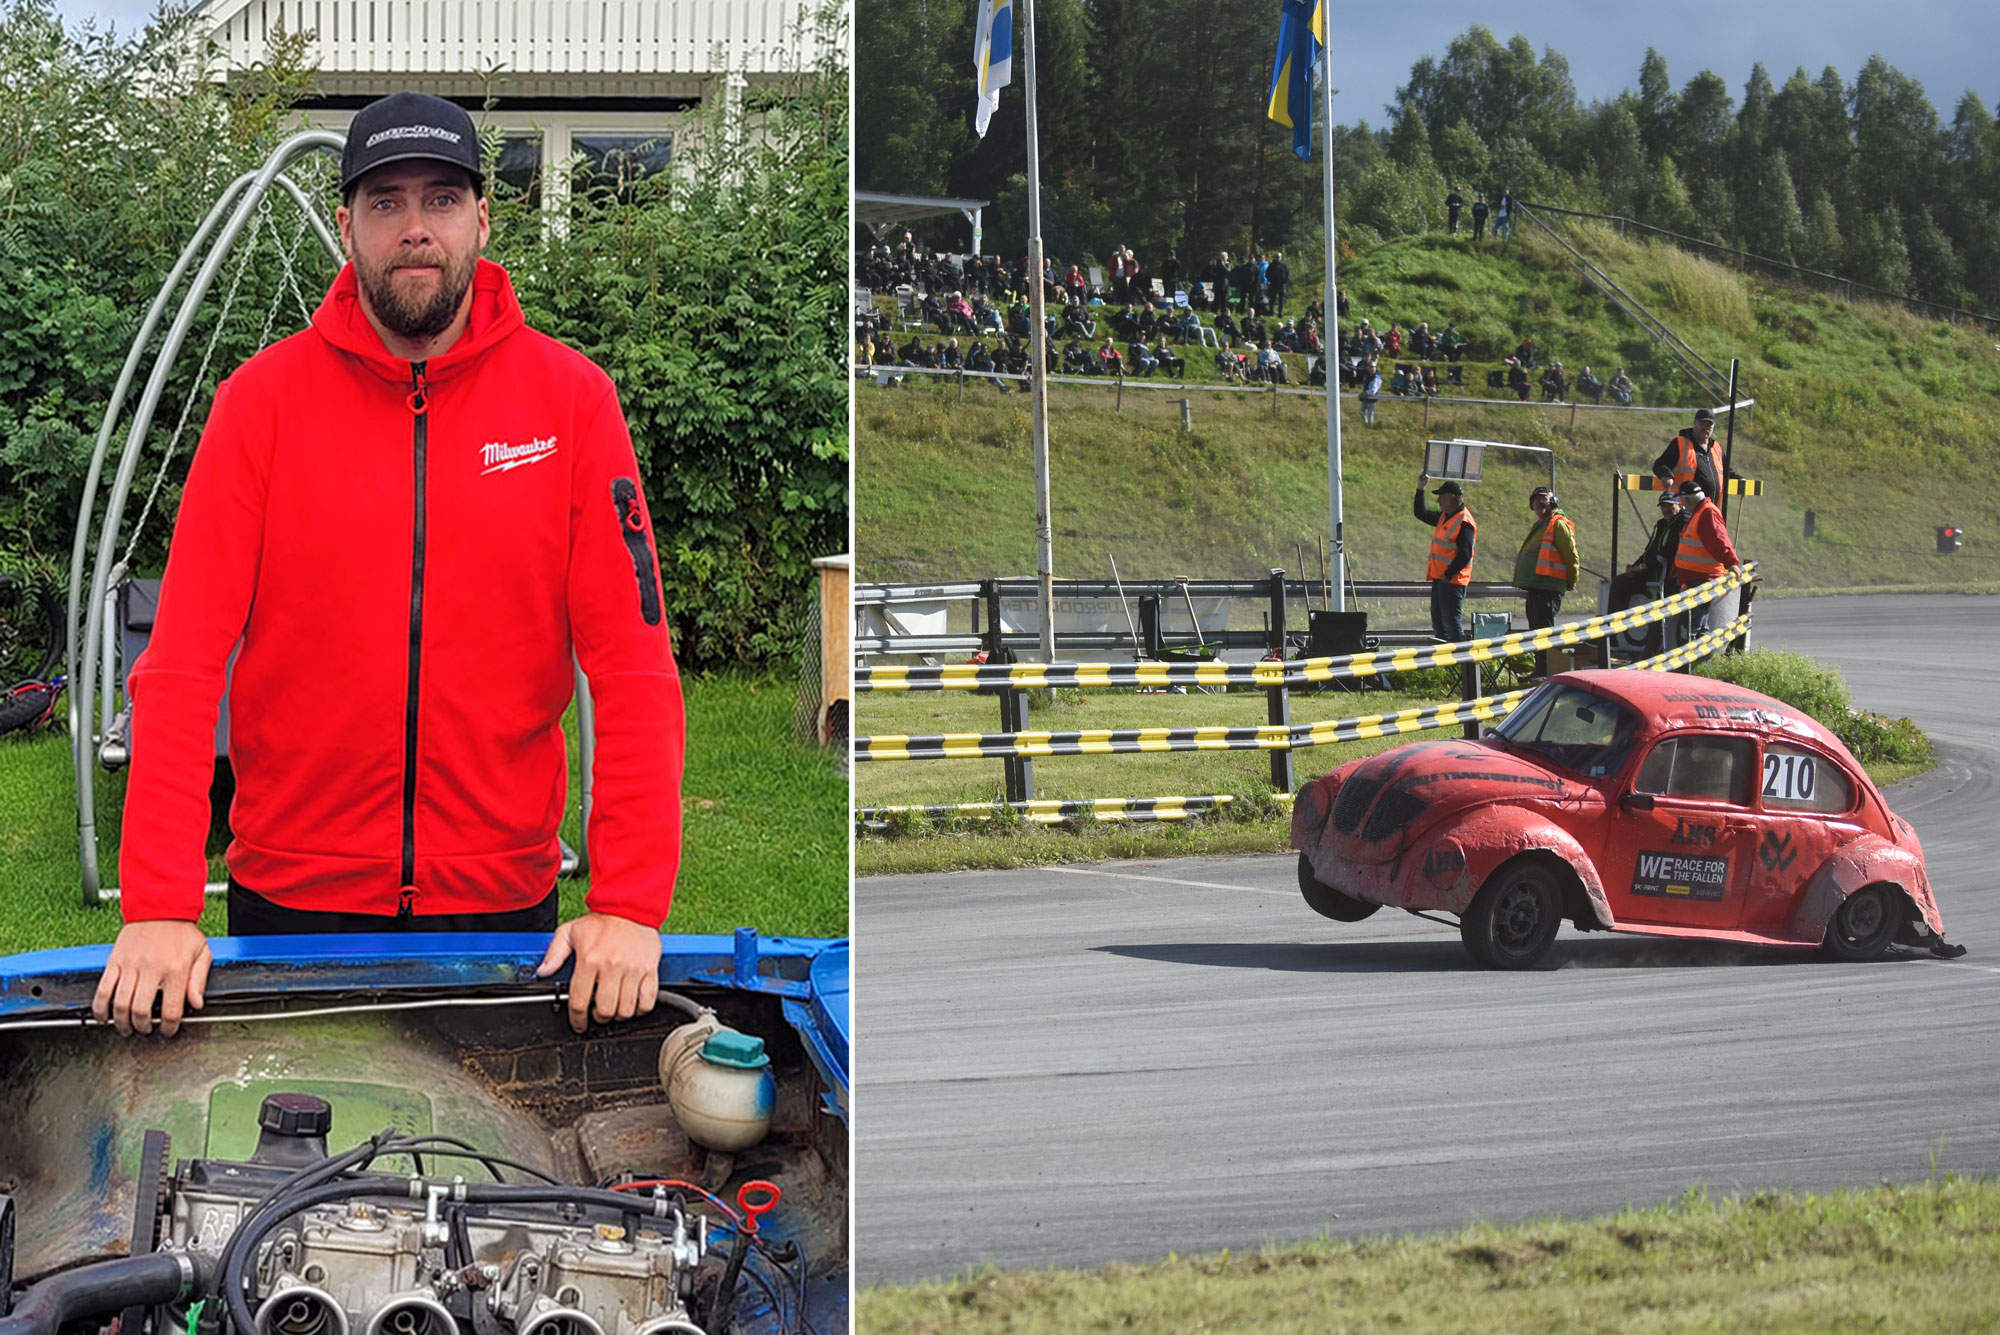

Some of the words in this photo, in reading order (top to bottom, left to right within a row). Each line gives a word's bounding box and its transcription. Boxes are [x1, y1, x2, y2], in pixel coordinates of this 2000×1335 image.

[479, 436, 557, 466] Milwaukee
[1763, 754, 1815, 799] 210
[1640, 855, 1674, 880] WE
[1674, 858, 1704, 872] RACE
[1704, 860, 1725, 874] FOR
[1673, 870, 1692, 881] THE
[1692, 872, 1724, 884] FALLEN
